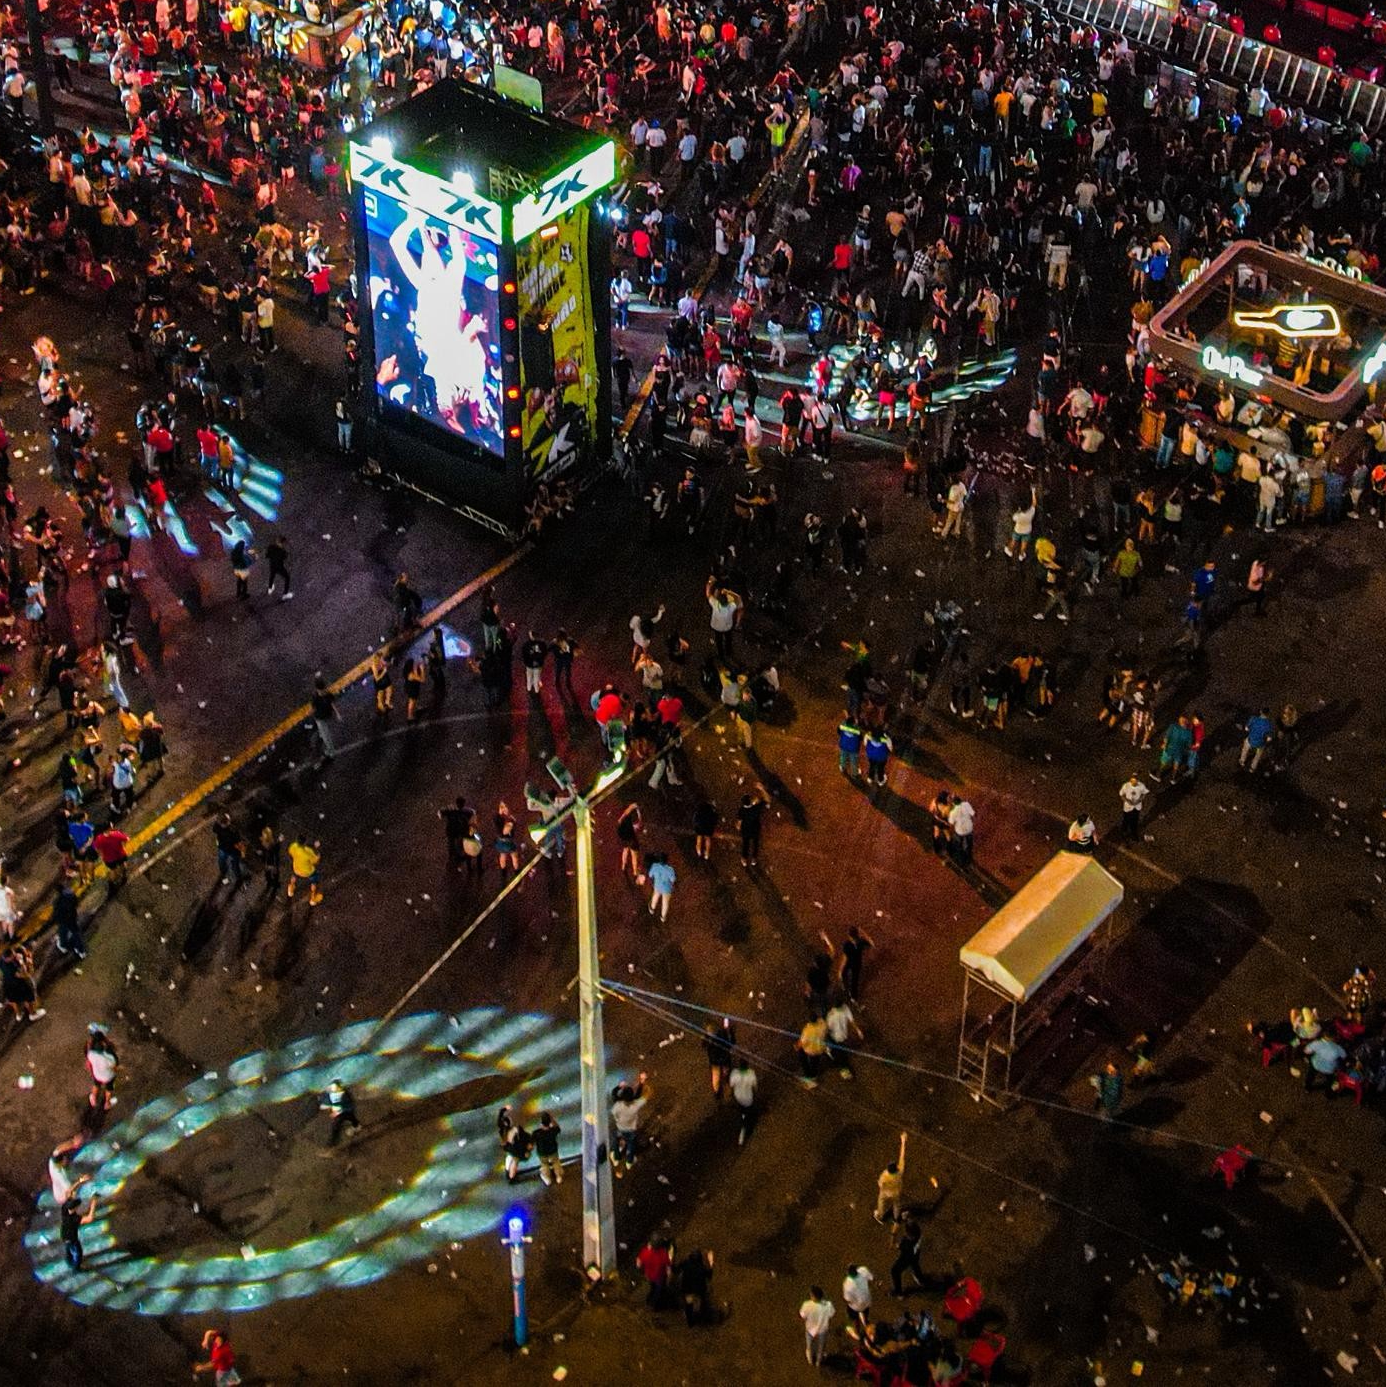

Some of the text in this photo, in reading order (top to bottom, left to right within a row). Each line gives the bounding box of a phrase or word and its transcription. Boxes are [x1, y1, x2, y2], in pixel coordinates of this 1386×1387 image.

[356, 151, 410, 196] 7K
[538, 169, 588, 217] 7K
[439, 186, 496, 234] 7K
[530, 421, 576, 477] 7K
